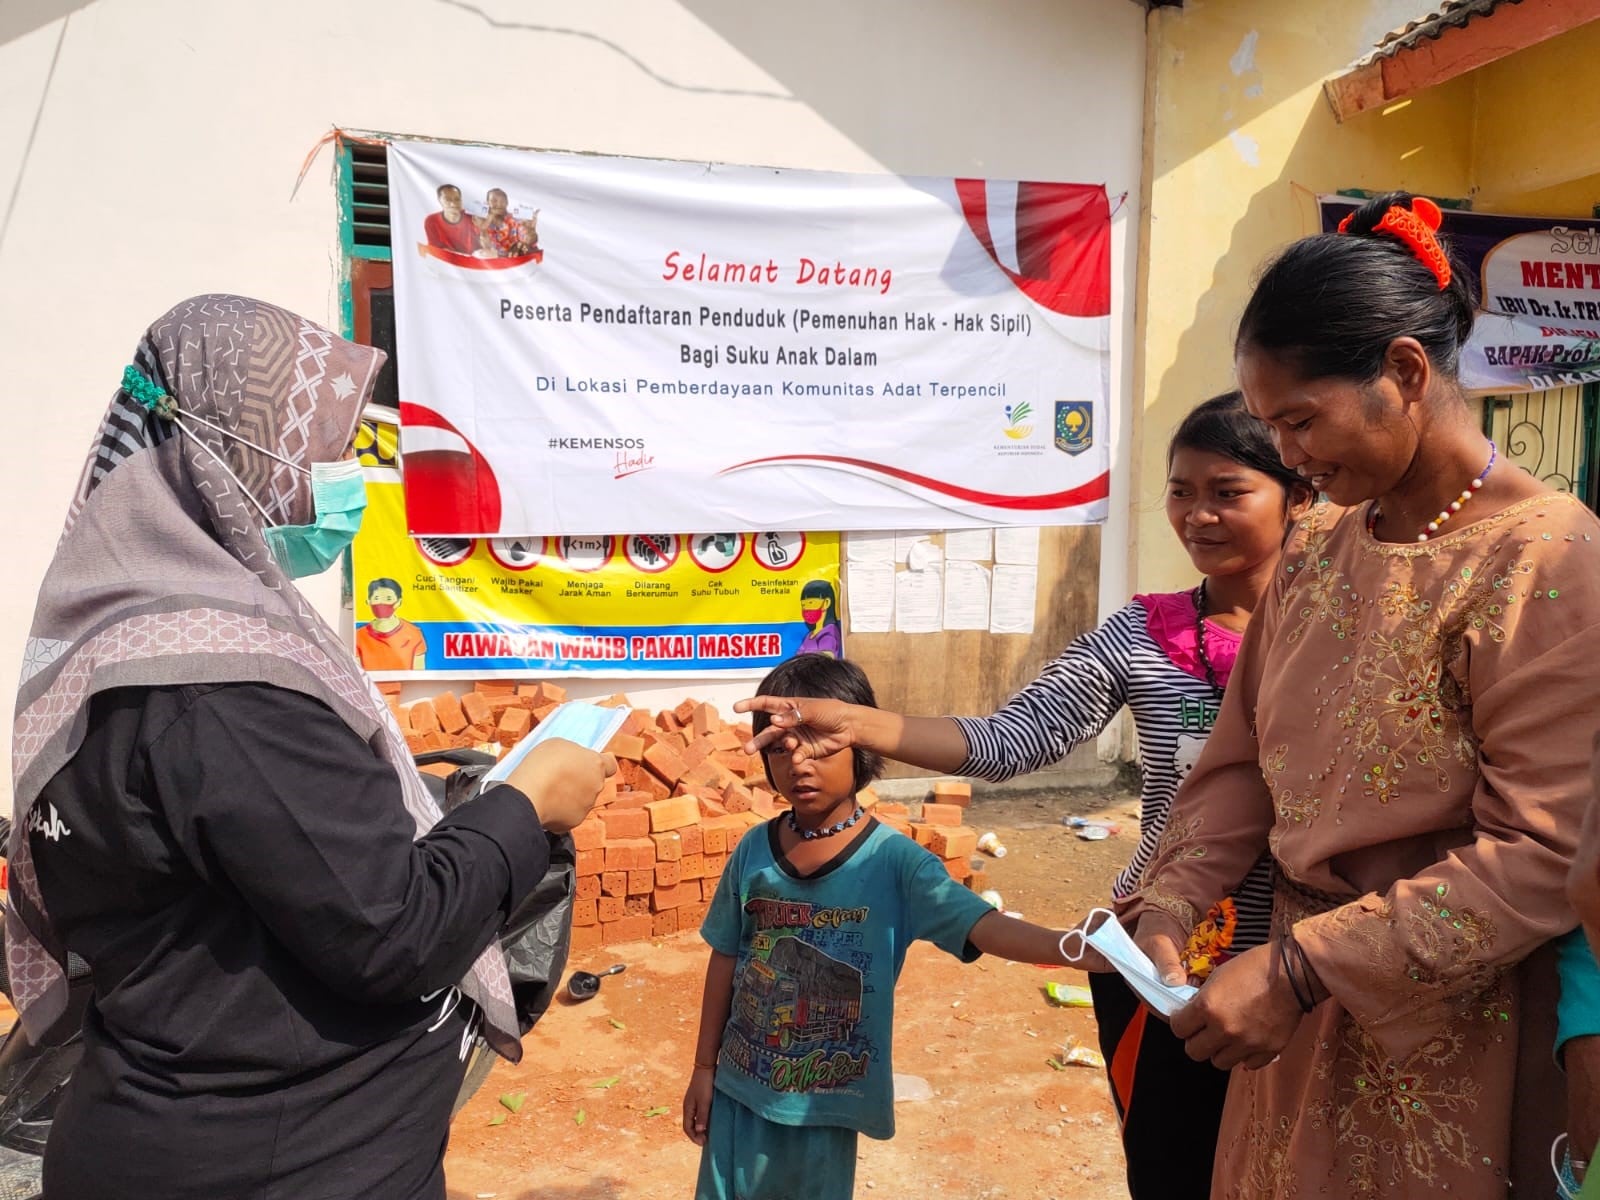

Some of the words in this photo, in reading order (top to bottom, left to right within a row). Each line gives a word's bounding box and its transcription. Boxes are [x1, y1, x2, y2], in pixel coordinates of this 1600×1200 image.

[1550, 226, 1600, 254] Sel
[662, 251, 778, 283] Selamat
[796, 258, 893, 294] Datang
[1495, 295, 1528, 314] IBU
[500, 299, 573, 323] Peserta
[580, 303, 693, 326] Pendaftaran
[700, 306, 786, 329] Penduduk
[793, 309, 898, 333] (Pemenuhan
[905, 312, 936, 331] Hak
[954, 314, 984, 333] Hak
[990, 315, 1033, 336] Sipil)
[680, 345, 719, 368] Bagi
[726, 346, 769, 365] Suku
[776, 346, 818, 366] Anak
[825, 347, 878, 367] Dalam
[1484, 344, 1549, 366] BAPAK
[536, 377, 556, 392] Di
[566, 377, 627, 393] Lokasi
[636, 379, 774, 399] Pemberdayaan
[782, 382, 875, 397] Komunitas
[882, 382, 922, 397] Adat
[929, 382, 1007, 399] Terpencil
[548, 438, 645, 449] #KEMENSOS
[613, 450, 655, 473] Hadir
[415, 574, 437, 583] Cuci
[491, 577, 516, 586] Wajib
[518, 579, 543, 588] Pakai
[751, 578, 799, 588] Desinfektan
[412, 583, 437, 592] Hand
[438, 584, 479, 593] Sanitizer
[567, 580, 604, 590] Menjaga
[634, 581, 671, 590] Dilarang
[708, 580, 723, 588] Cek
[500, 586, 534, 596] Masker
[559, 588, 583, 597] Jarak
[585, 589, 612, 597] Aman
[626, 589, 679, 598] Berkerumun
[691, 588, 712, 597] Suhu
[714, 587, 740, 596] Tubuh
[760, 587, 791, 596] Berkala
[445, 634, 554, 658] KAWAAN
[561, 637, 626, 659] WAJIB
[632, 636, 692, 660] PAKAI
[699, 633, 780, 657] MASKER
